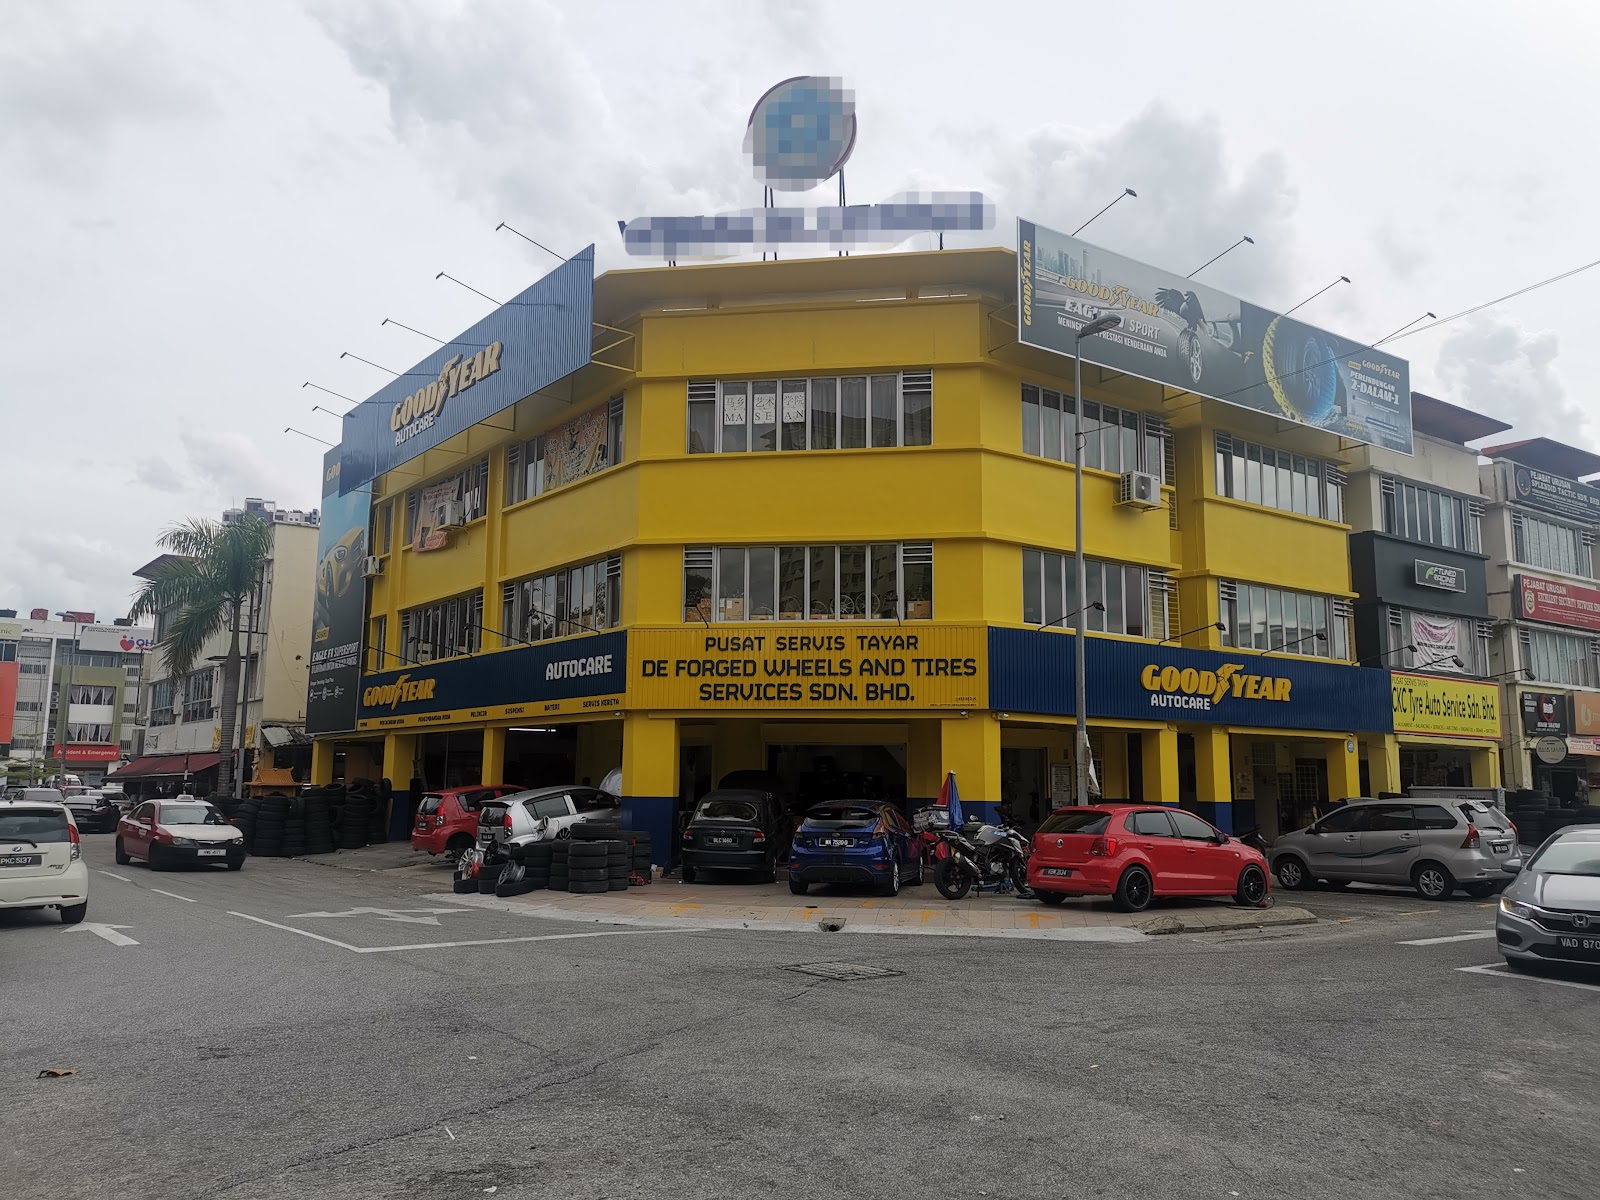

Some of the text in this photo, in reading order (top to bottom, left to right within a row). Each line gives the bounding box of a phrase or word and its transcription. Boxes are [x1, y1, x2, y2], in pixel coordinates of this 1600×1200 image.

[1021, 240, 1032, 326] GOODYEAR
[1065, 274, 1160, 318] GOODYEAR
[1129, 319, 1160, 340] SPORT
[1099, 330, 1124, 345] PRESTASI
[1123, 338, 1154, 354] KENDERAAN
[1153, 346, 1168, 358] ANDA
[1362, 359, 1400, 380] GOODYEAR
[391, 340, 502, 432] GOODYEAR
[1350, 370, 1396, 393] PERLINDUNGAN
[1351, 379, 1400, 406] 2-DALAM-1
[395, 411, 436, 447] AUTOCARE
[1530, 470, 1571, 490] PEJABAT URUSAN
[1557, 487, 1577, 499] TACTIC
[1523, 578, 1567, 595] PEJABAT URUSAN
[705, 635, 919, 652] PUSAT SERVIS TAYAR
[311, 650, 328, 662] EAGLE
[545, 654, 613, 681] AUTOCARE
[642, 658, 977, 677] DE FORGED WHEELS AND TIRES
[363, 673, 436, 710] GOODYEAR
[699, 682, 915, 701] SERVICES SDN. BHD.
[1141, 663, 1292, 705] GOODYEAR
[505, 707, 525, 715] SUSPENSI
[544, 703, 560, 711] BATERI
[582, 698, 620, 708] SERVIS KERETA
[1150, 693, 1211, 710] AUTOCARE
[1392, 686, 1407, 713] CKC
[1408, 688, 1423, 722] Tyre
[1425, 689, 1441, 716] Auto
[1442, 691, 1466, 718] Service
[1467, 693, 1482, 719] Sdn.
[1482, 694, 1497, 721] Bhd.
[16, 856, 32, 864] 5137
[1561, 937, 1579, 948] VAD
